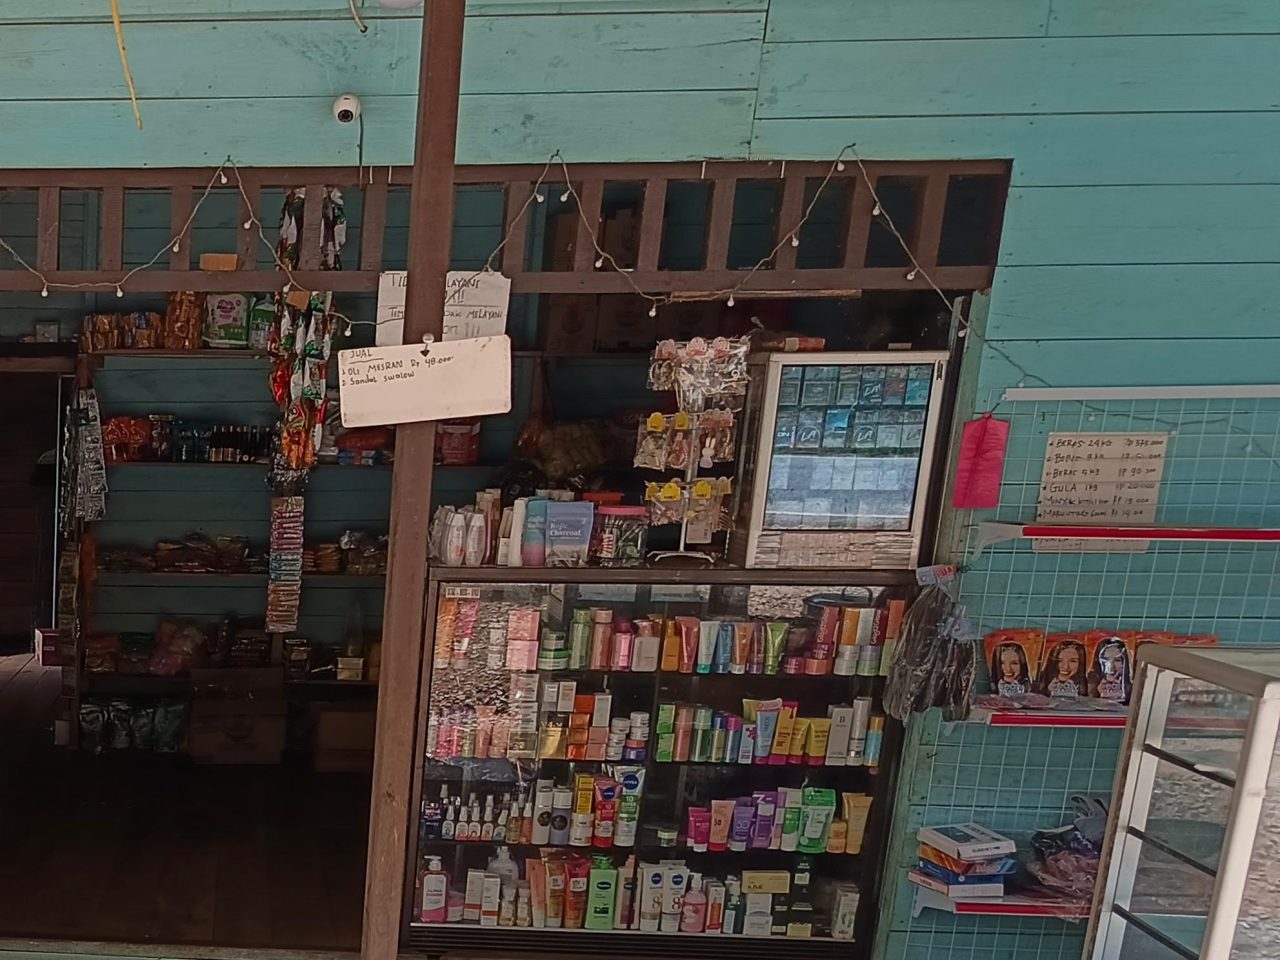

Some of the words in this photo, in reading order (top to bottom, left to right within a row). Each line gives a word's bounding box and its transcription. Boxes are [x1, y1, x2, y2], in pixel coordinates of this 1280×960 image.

[385, 272, 407, 287] TID
[446, 278, 481, 289] LAYANI
[388, 306, 404, 318] TIM
[466, 308, 504, 321] MELAYANI
[350, 348, 373, 359] JUAL
[348, 367, 360, 376] OLI
[367, 359, 404, 374] MESRAN
[1049, 483, 1077, 493] GULA
